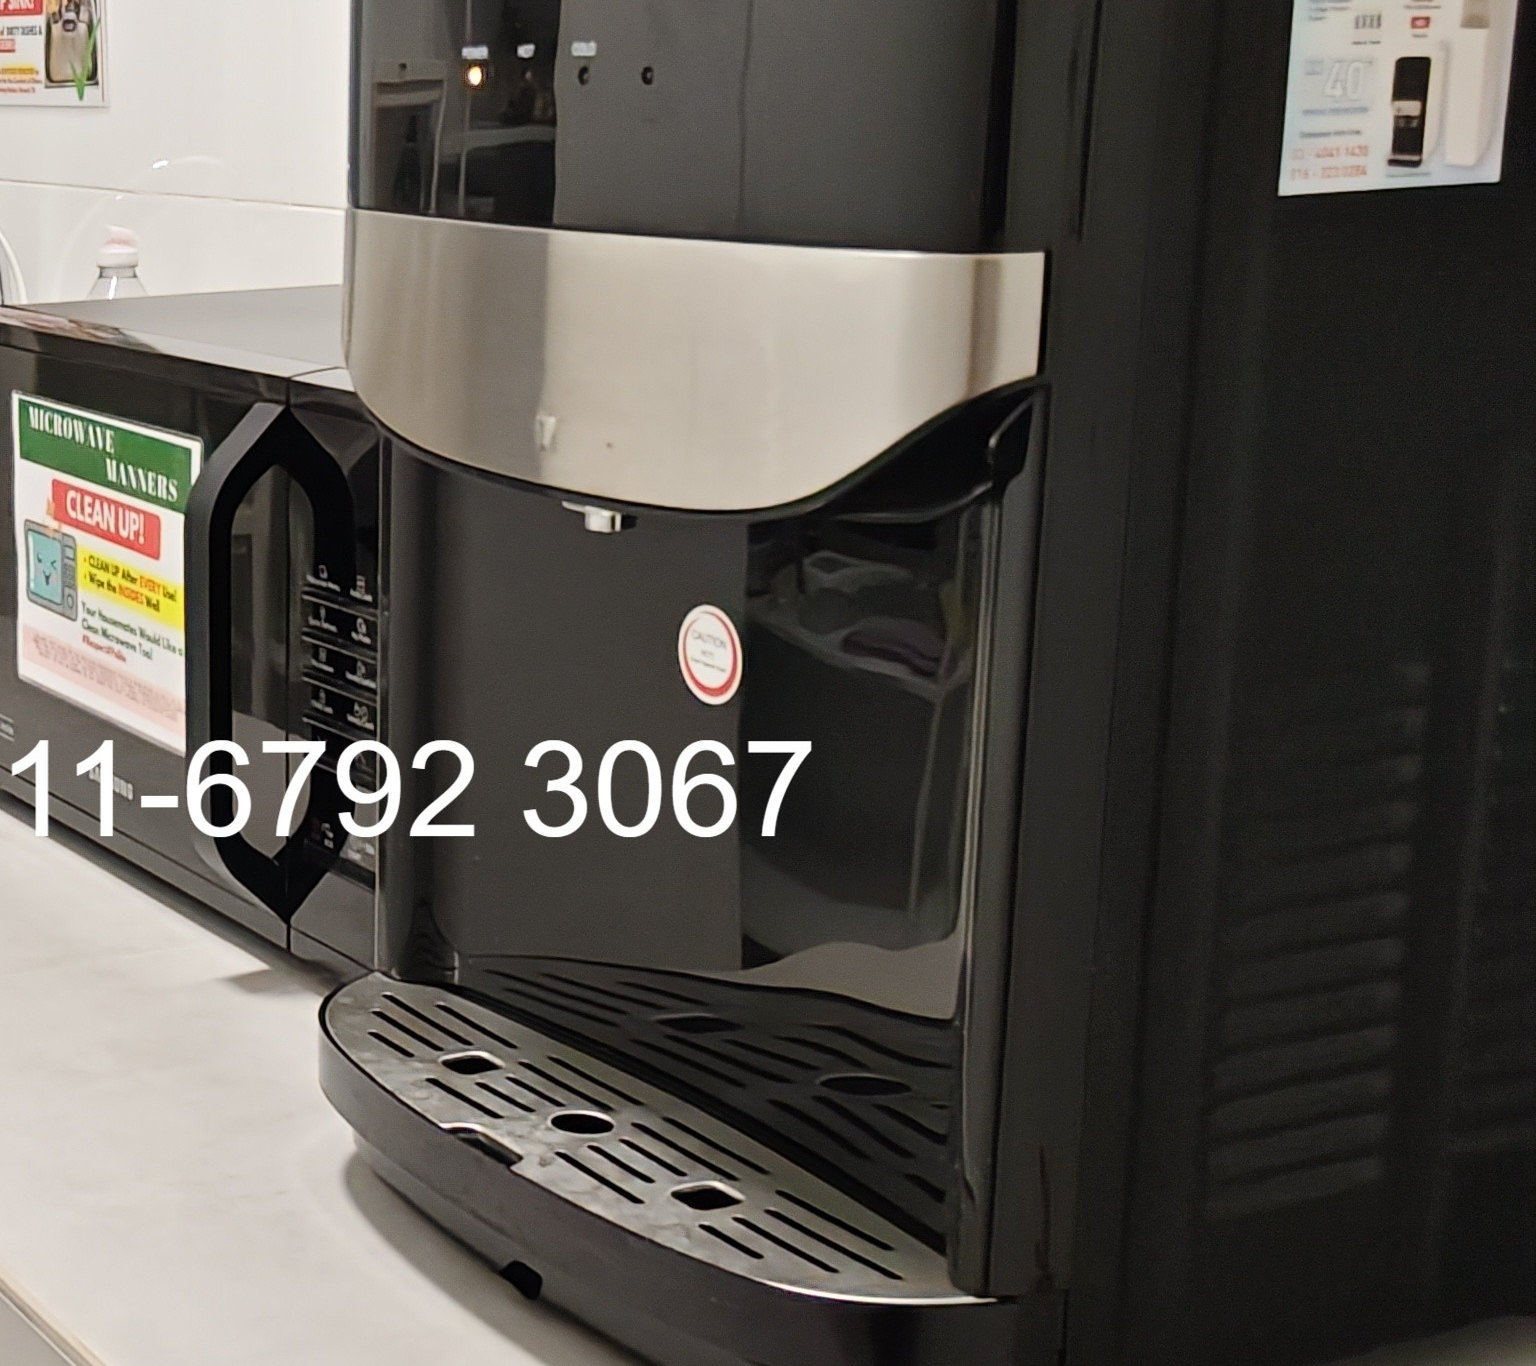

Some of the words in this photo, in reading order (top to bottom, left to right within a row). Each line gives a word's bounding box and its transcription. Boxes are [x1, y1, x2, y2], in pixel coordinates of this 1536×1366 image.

[28, 405, 115, 454] MICROWAVE
[105, 457, 179, 503] MANNERS
[66, 489, 116, 534] CLEAN
[118, 506, 146, 546] UP!
[88, 554, 110, 574] CLEAN
[112, 564, 120, 577] UP
[121, 568, 138, 585] After
[139, 575, 161, 595] EVERY
[88, 571, 105, 590] Wipe
[106, 579, 117, 594] the
[145, 595, 161, 613] Well
[81, 601, 96, 617] Your
[138, 627, 161, 647] Would
[162, 636, 177, 654] Like
[101, 627, 137, 652] Microwave
